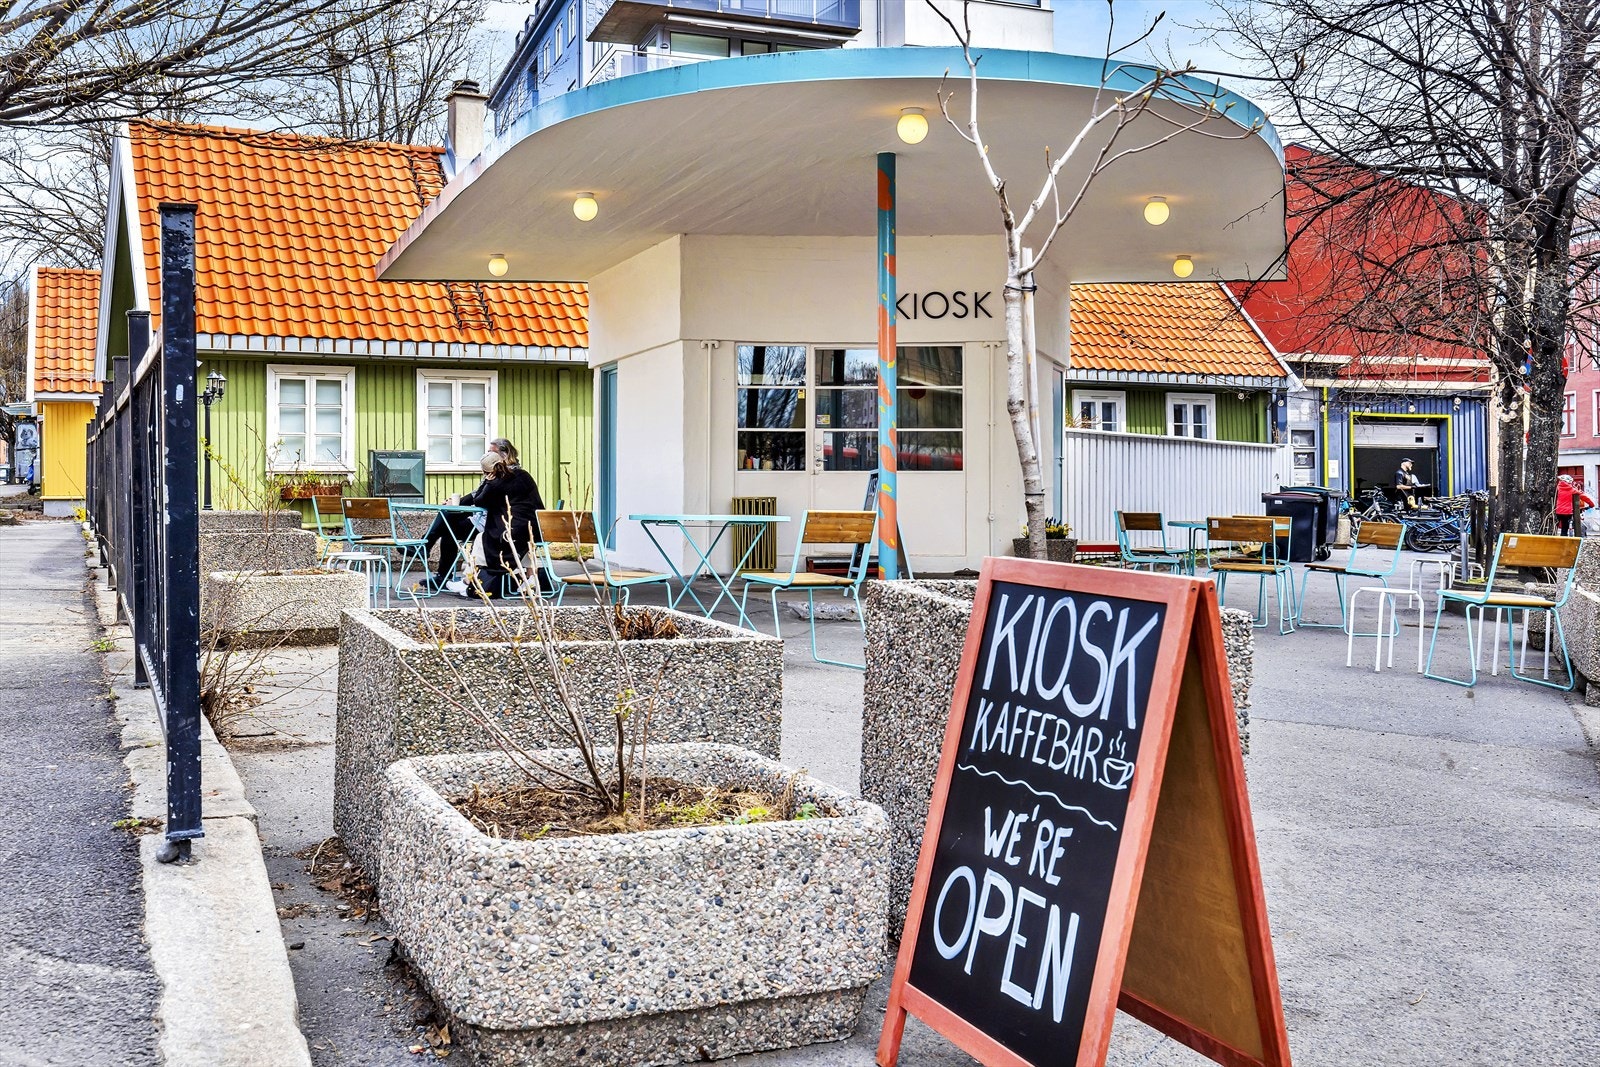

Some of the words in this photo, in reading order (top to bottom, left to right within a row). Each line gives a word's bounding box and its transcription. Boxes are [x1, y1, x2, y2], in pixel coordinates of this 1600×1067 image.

[896, 291, 993, 320] KIOSK
[983, 593, 1158, 729] KIOSK
[970, 697, 1103, 783] KAFFEBAR
[983, 804, 1074, 886] WE'RE
[933, 865, 1080, 1023] OPEN
